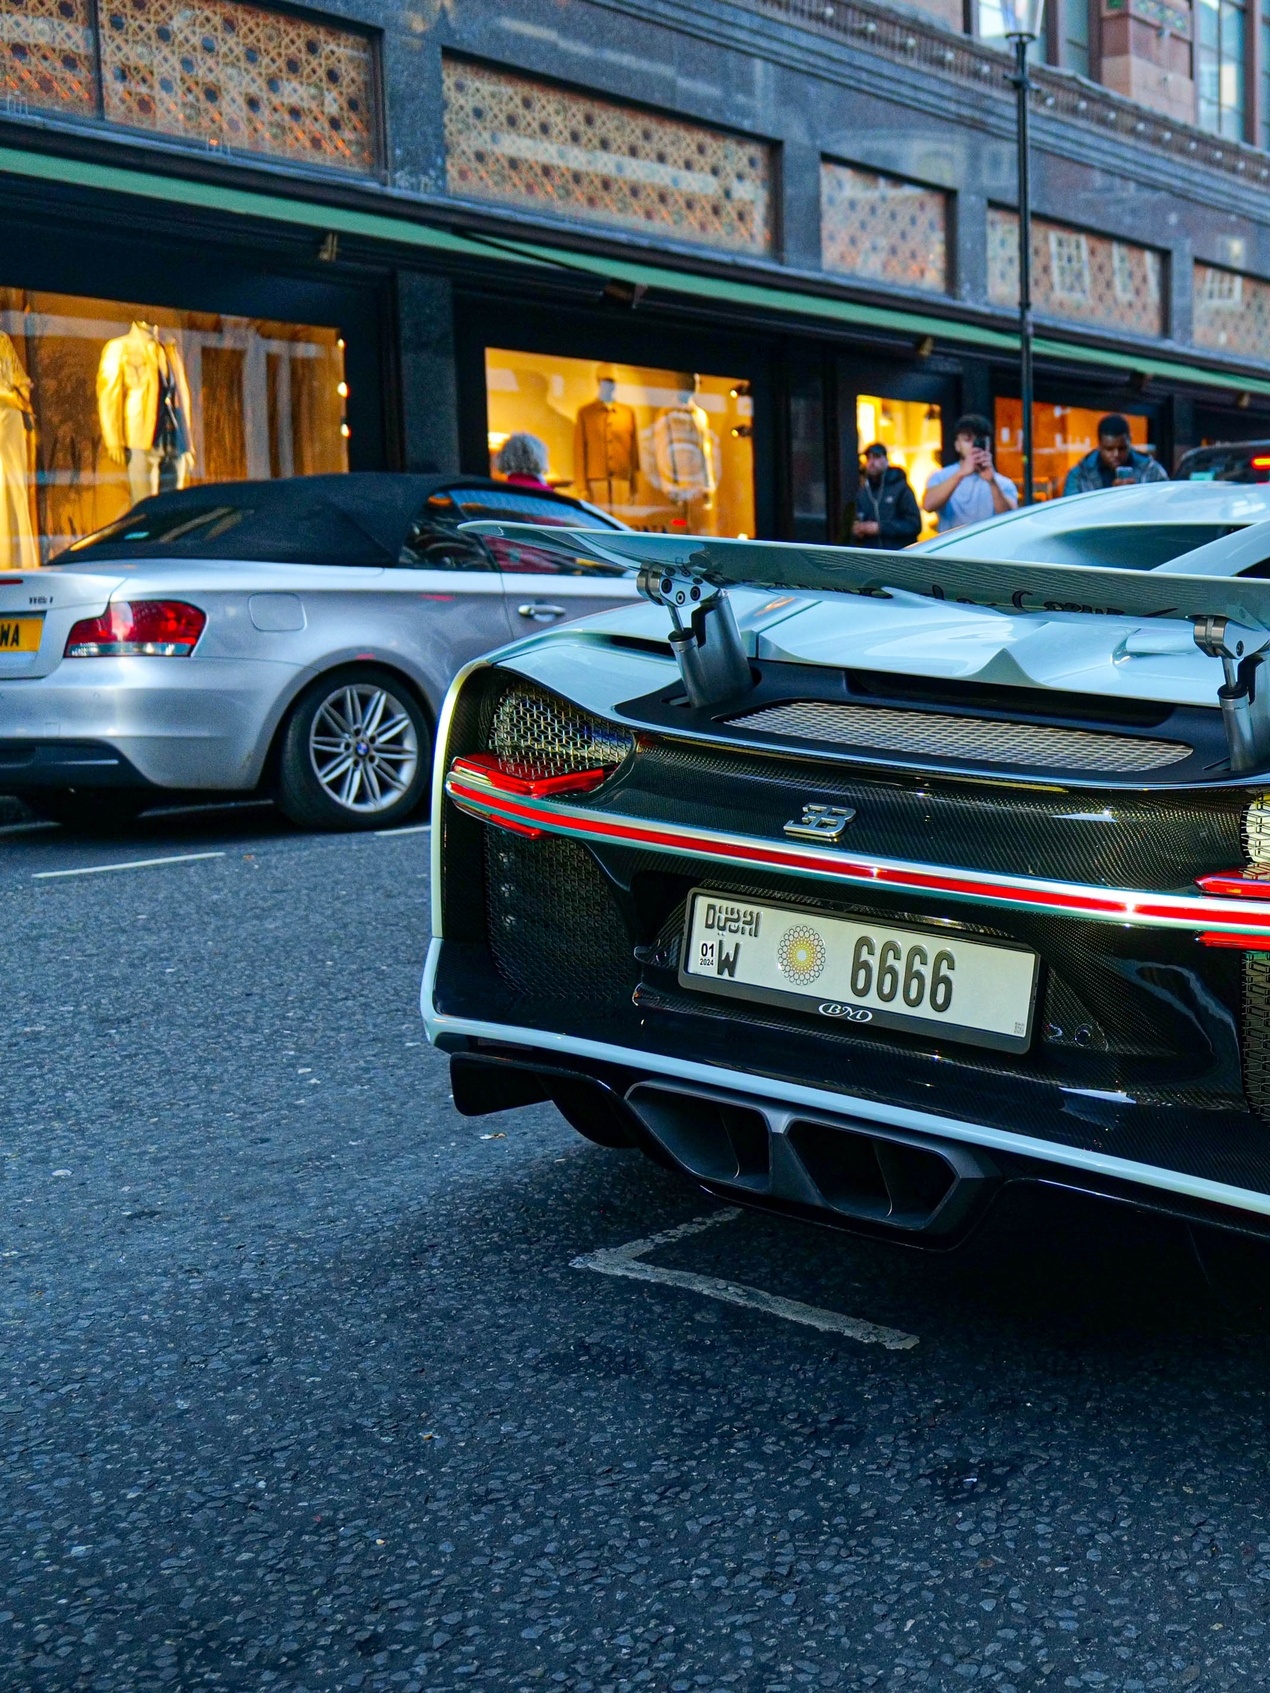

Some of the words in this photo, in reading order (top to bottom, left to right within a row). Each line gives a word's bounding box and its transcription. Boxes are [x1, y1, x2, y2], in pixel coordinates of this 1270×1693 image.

[701, 942, 715, 958] 01
[699, 958, 715, 967] 2024
[717, 939, 741, 978] W
[850, 935, 956, 1013] 6666
